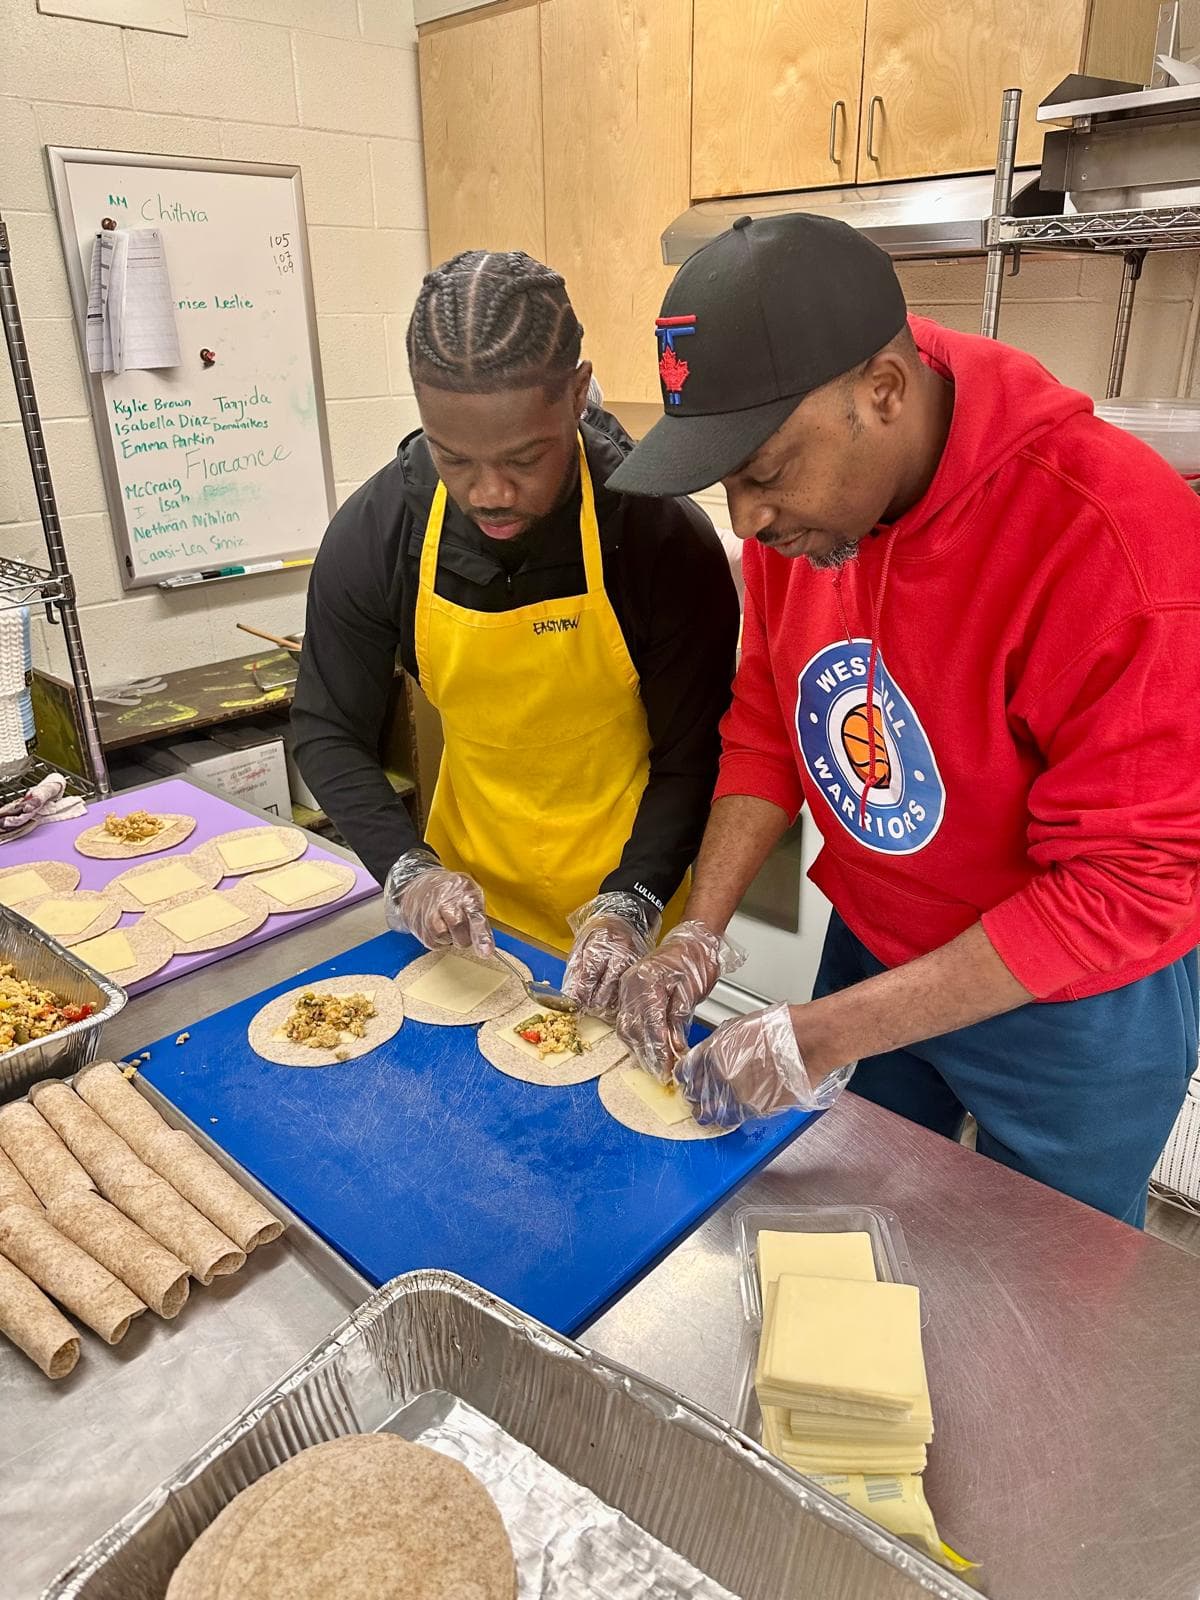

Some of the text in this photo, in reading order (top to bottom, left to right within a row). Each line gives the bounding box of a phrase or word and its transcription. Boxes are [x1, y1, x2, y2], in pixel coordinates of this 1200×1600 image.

[141, 193, 209, 222] Chithra
[269, 232, 291, 248] 105
[273, 250, 292, 264] 107
[277, 261, 294, 276] 109
[214, 293, 254, 309] Leslie
[112, 397, 192, 420] Kylie Brown
[114, 414, 175, 436] Isabella
[120, 438, 169, 459] Emma
[813, 756, 927, 839] WARRIORS
